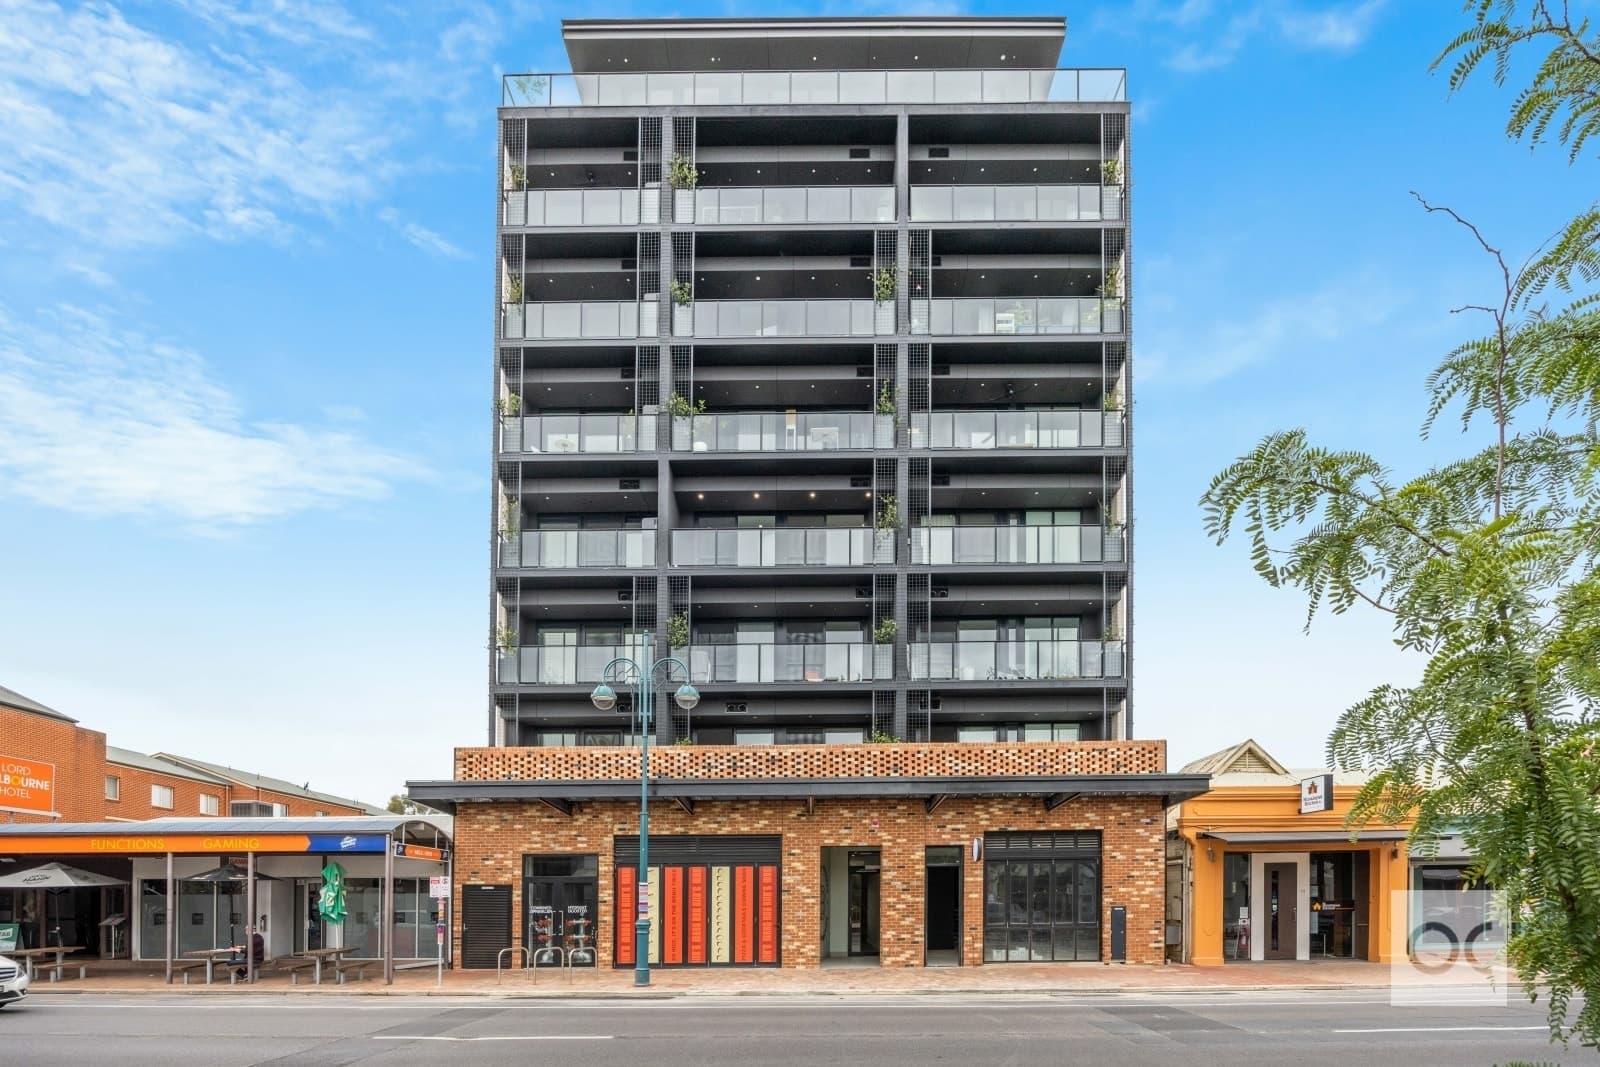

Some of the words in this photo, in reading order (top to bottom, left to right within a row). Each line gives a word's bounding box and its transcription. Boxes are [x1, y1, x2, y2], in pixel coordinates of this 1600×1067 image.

[2, 763, 31, 775] LORD
[0, 773, 50, 790] LBOURNE
[0, 786, 31, 799] HOTEL
[91, 839, 165, 850] FUNCTIONS
[202, 838, 260, 849] GAMING
